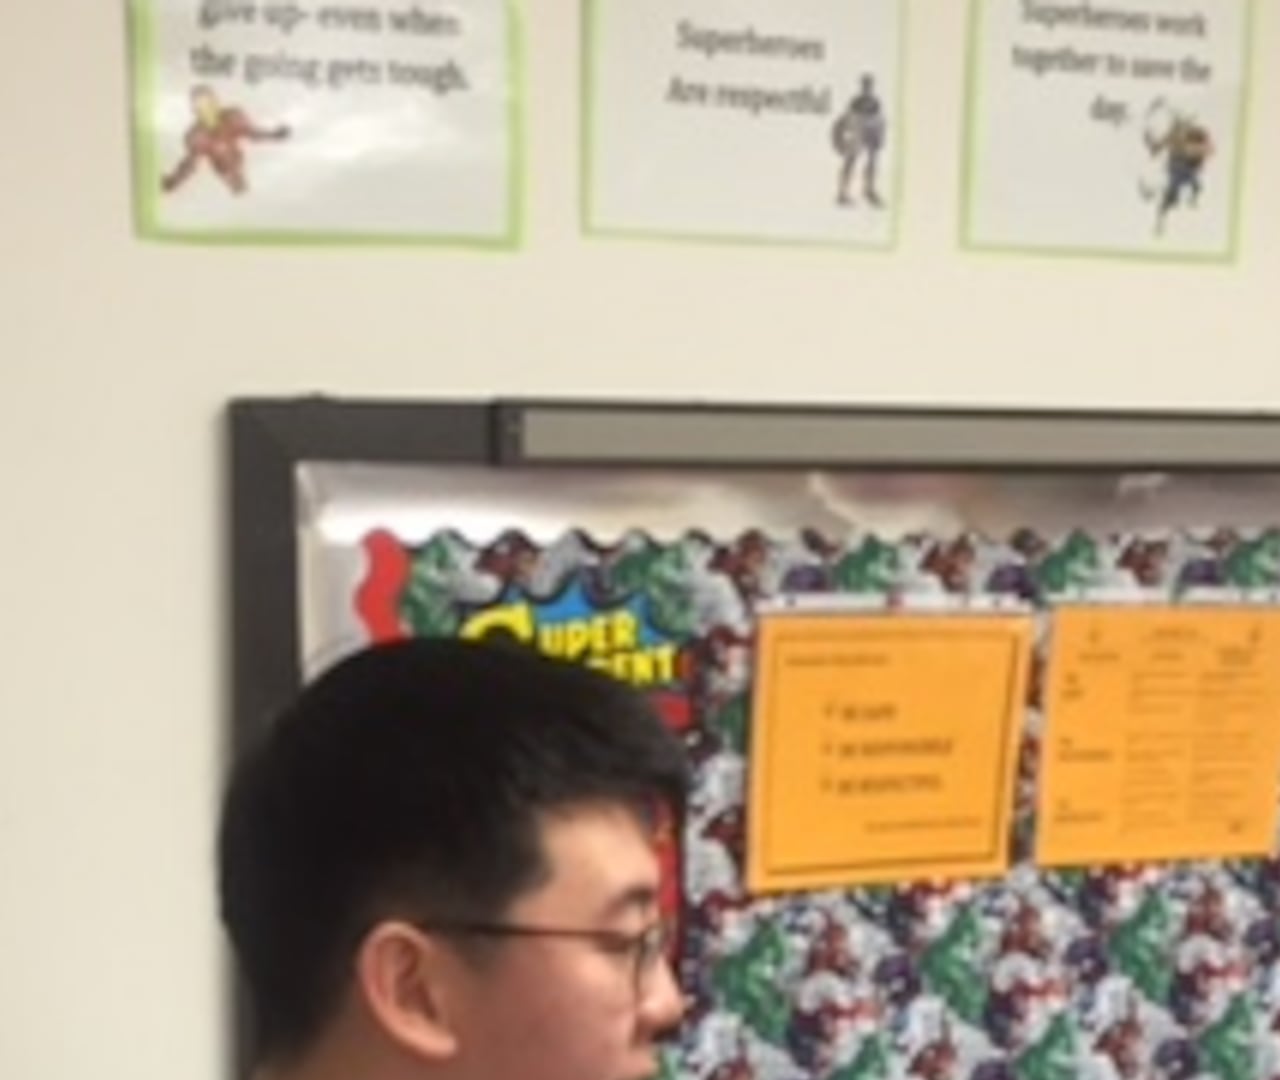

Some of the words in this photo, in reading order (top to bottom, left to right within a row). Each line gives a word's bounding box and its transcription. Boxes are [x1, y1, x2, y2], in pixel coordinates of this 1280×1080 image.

[317, 7, 381, 33] even
[384, 5, 464, 36] when
[675, 18, 826, 60] Superheroes
[1020, 0, 1150, 31] Superheroes
[1155, 11, 1206, 38] work
[189, 42, 237, 77] the
[243, 48, 322, 88] going
[326, 56, 382, 87] gets
[1011, 42, 1097, 79] together
[1105, 52, 1126, 77] to
[1130, 59, 1174, 80] save
[1179, 53, 1212, 83] the
[667, 74, 707, 108] Are
[716, 84, 832, 117] respectful
